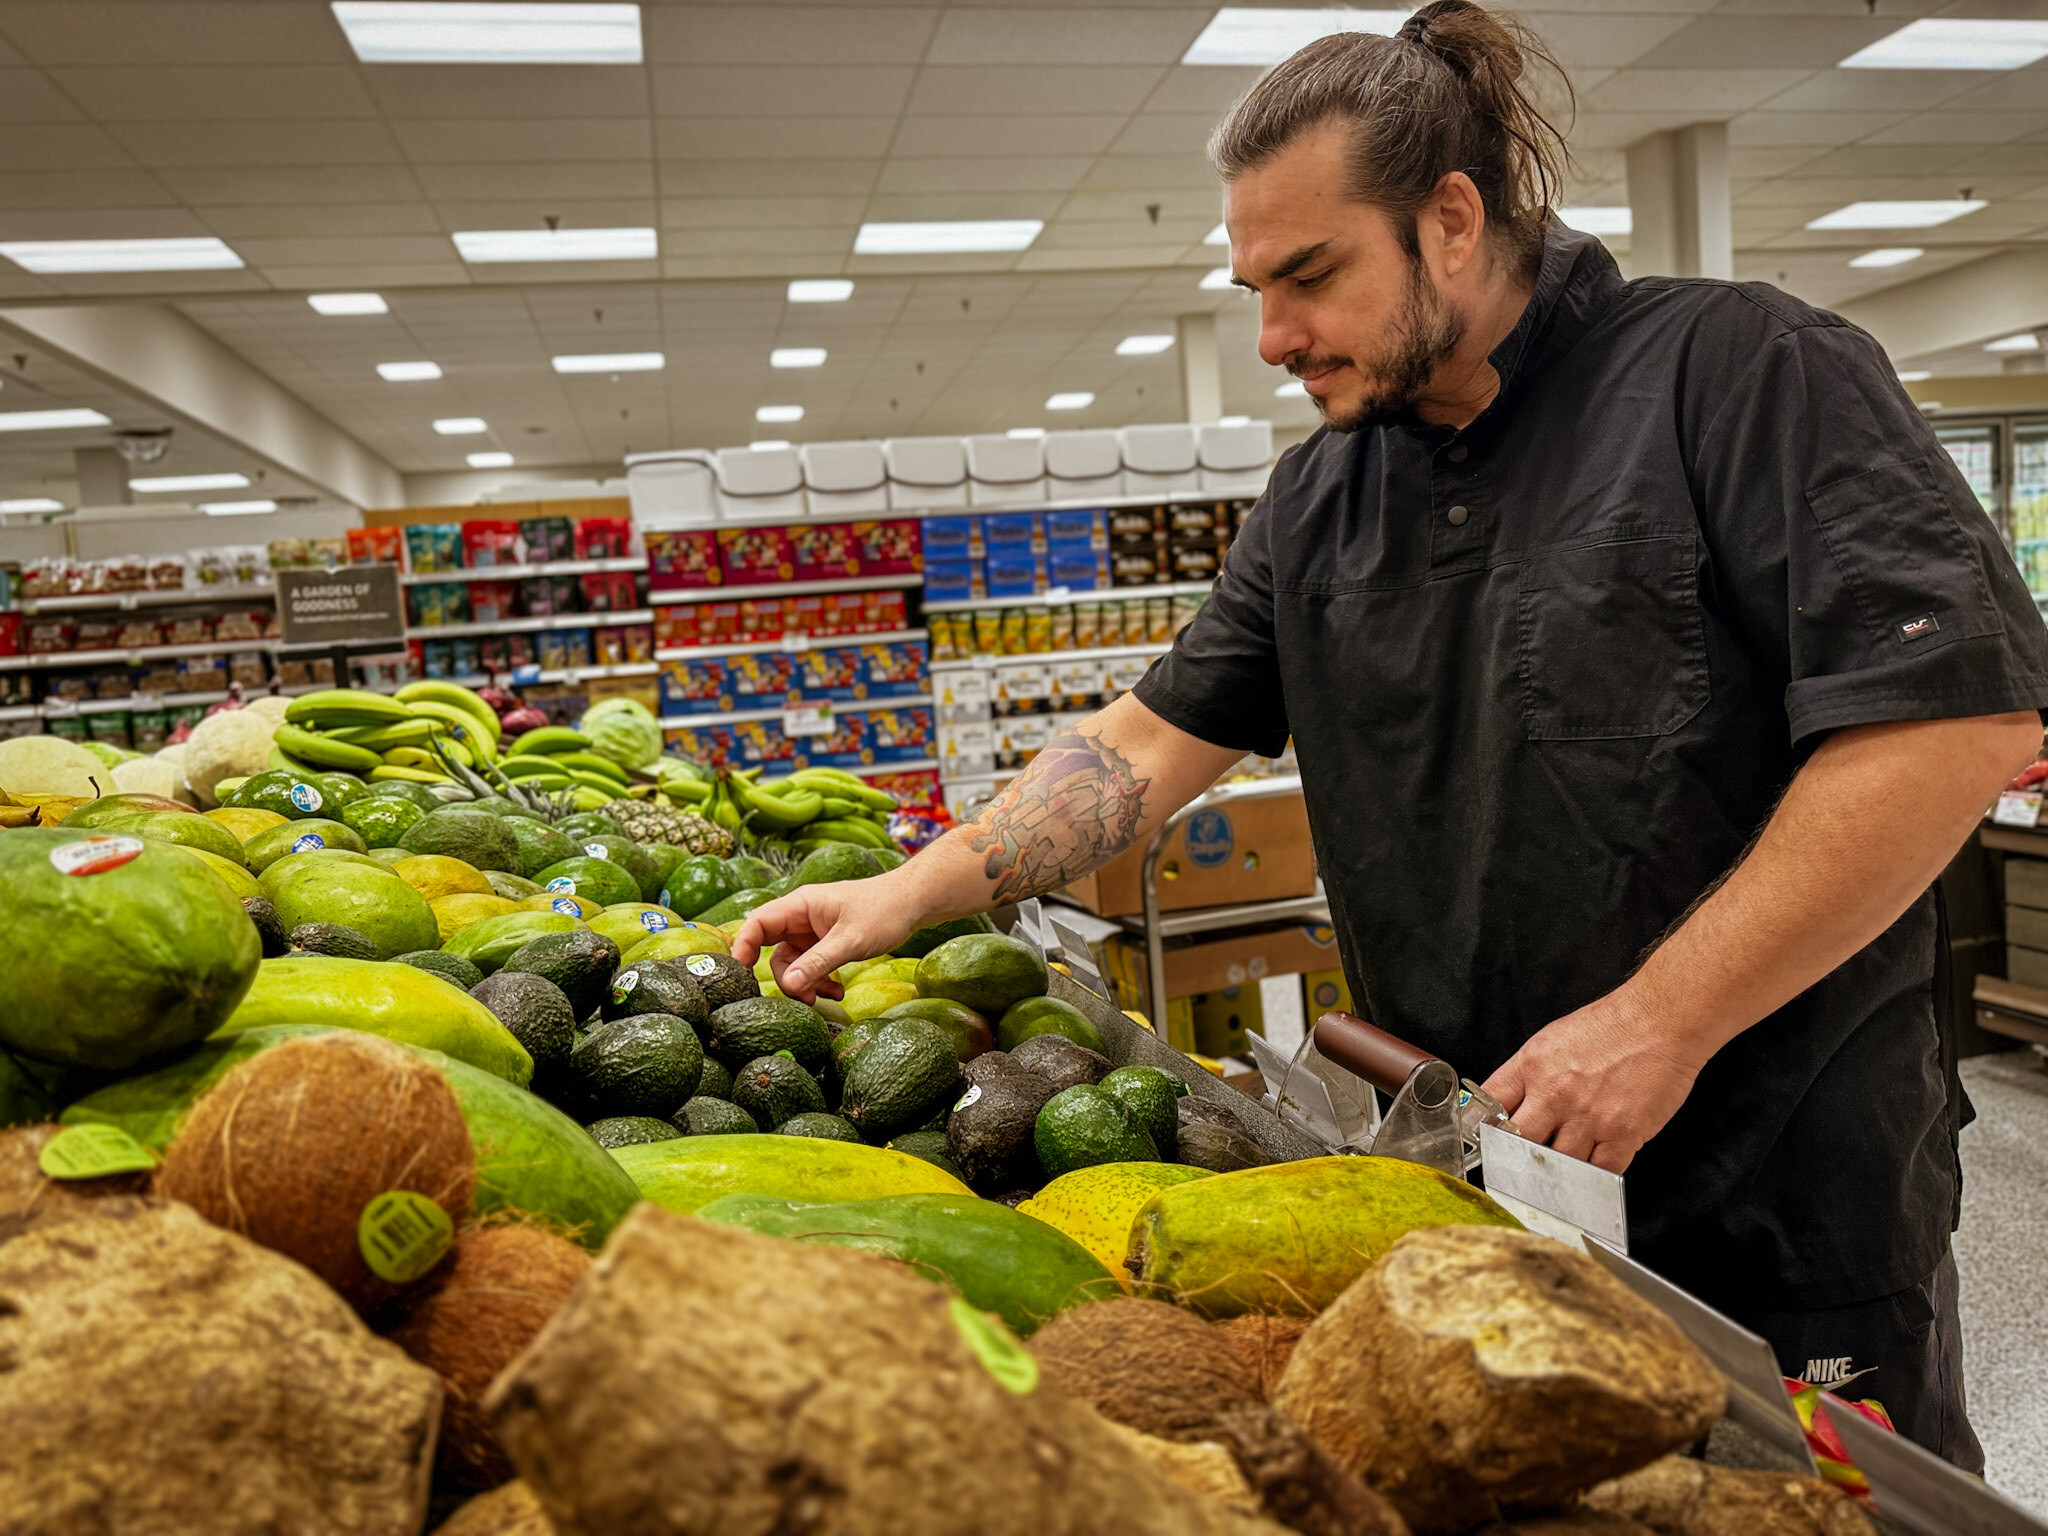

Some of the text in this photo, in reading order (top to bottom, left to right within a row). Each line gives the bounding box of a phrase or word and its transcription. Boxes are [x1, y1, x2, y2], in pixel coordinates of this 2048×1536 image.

[292, 583, 369, 598] A GARDEN OF
[293, 599, 358, 611] GOODNESS
[1805, 1357, 1852, 1382] NIKE
